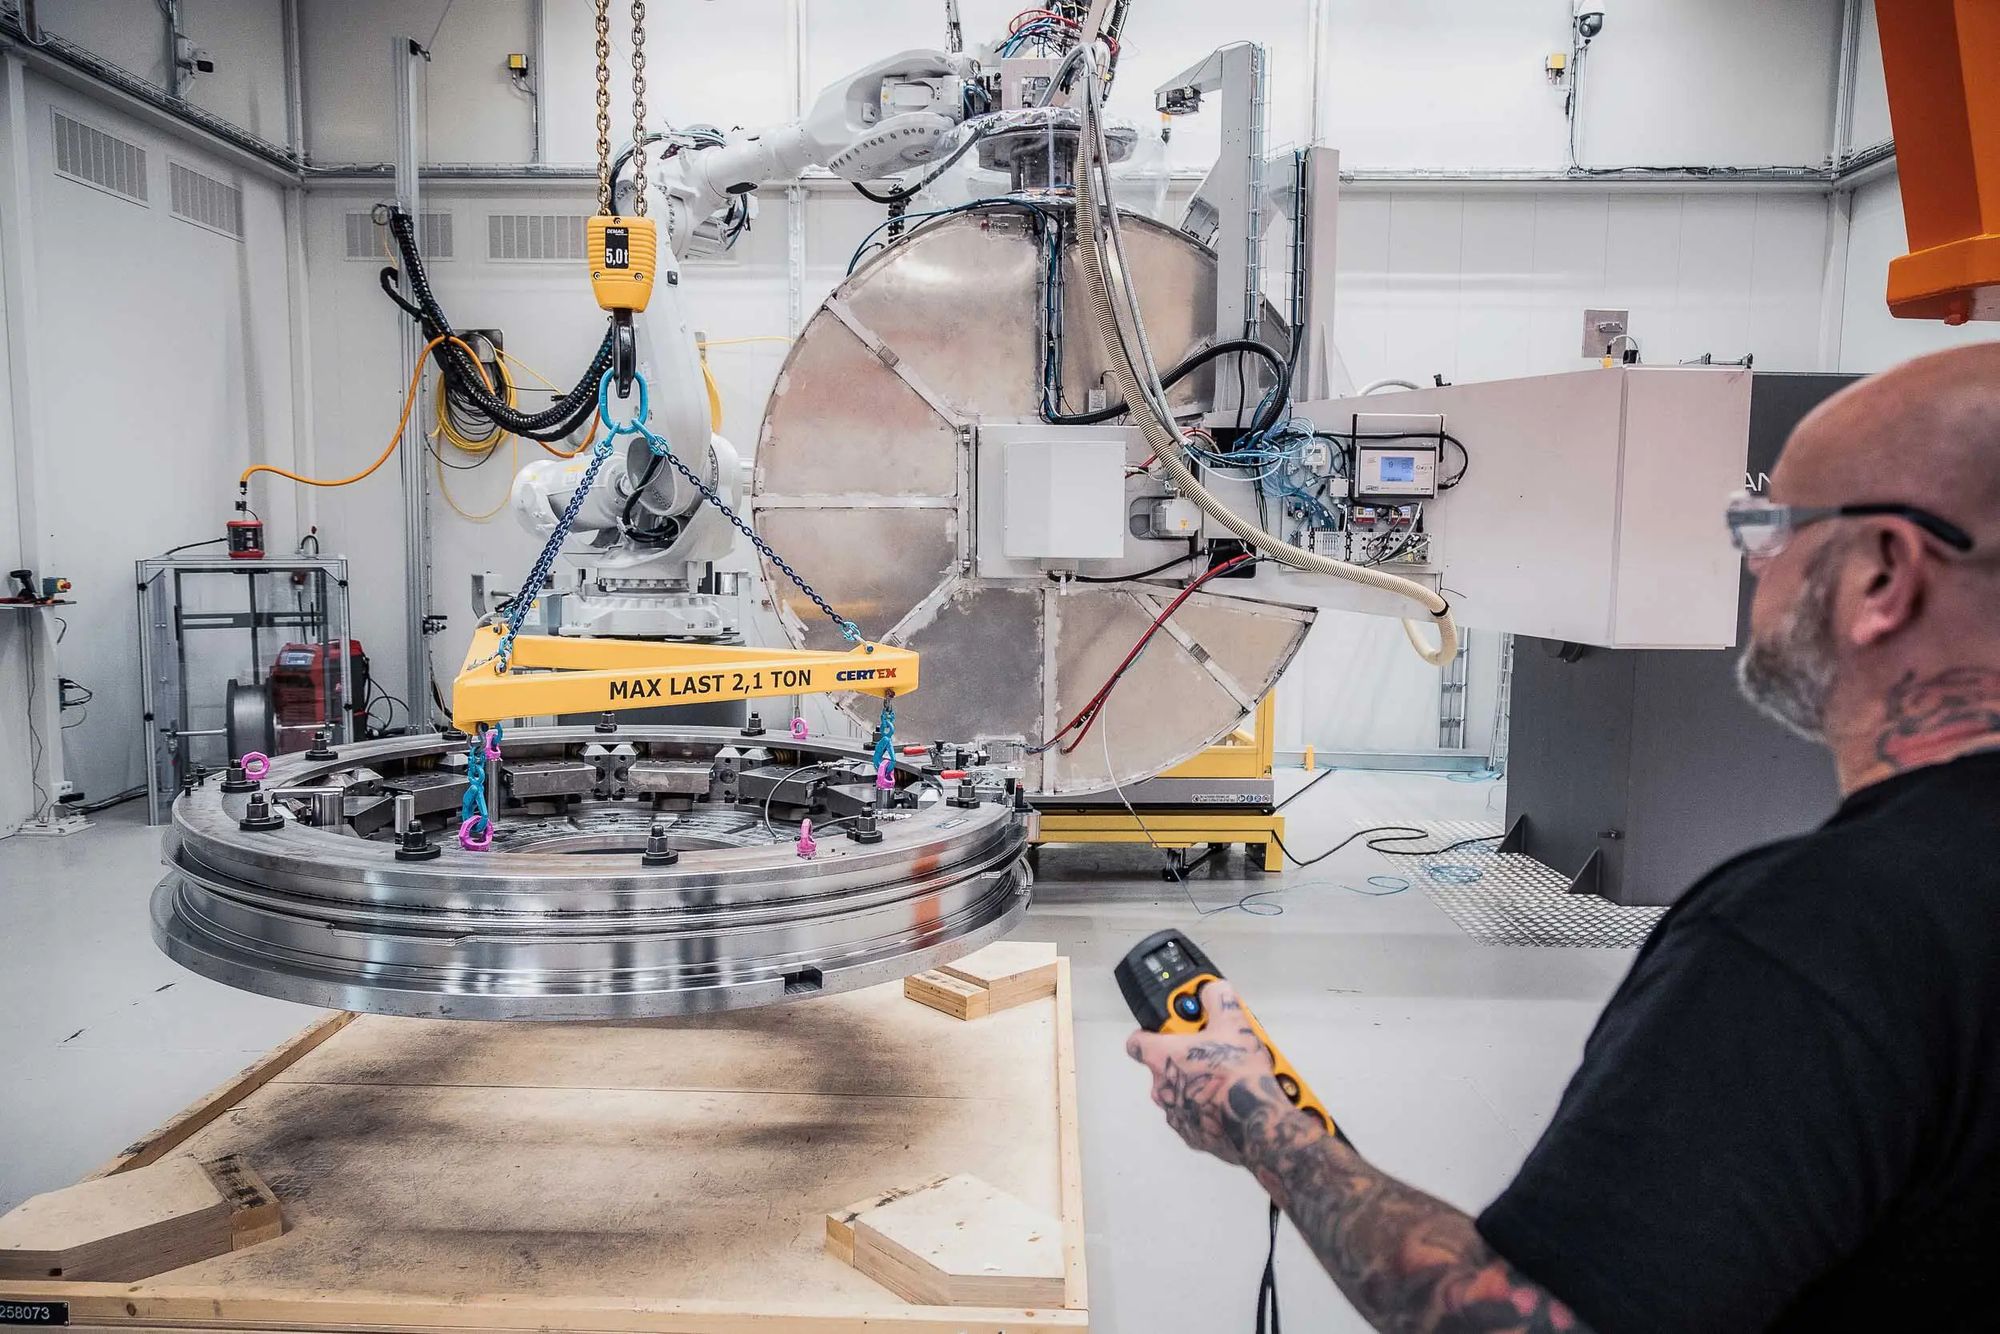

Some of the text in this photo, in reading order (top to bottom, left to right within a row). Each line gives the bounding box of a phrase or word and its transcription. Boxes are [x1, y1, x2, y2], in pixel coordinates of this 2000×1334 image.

[836, 668, 896, 682] CERTEX
[610, 669, 811, 700] MAX LAST 2,1 TON
[0, 1305, 50, 1320] 258073
